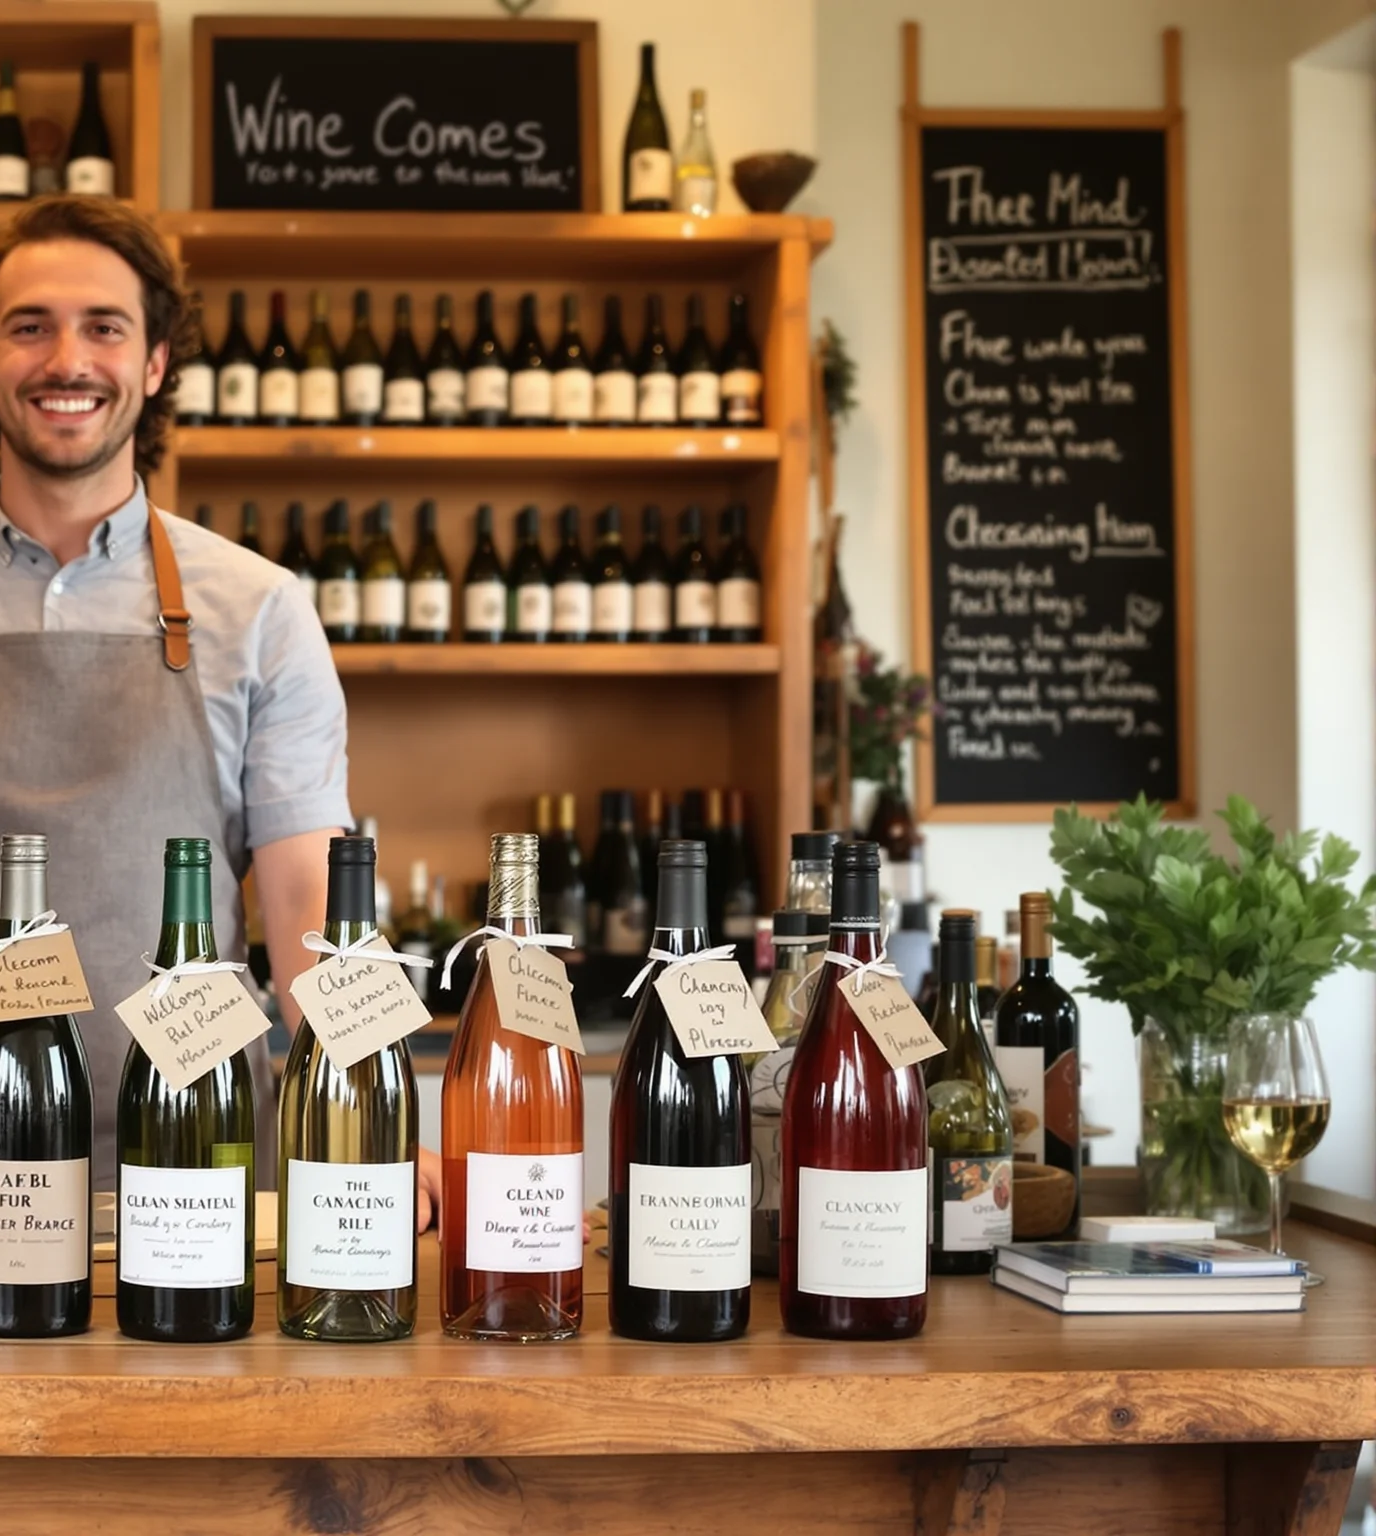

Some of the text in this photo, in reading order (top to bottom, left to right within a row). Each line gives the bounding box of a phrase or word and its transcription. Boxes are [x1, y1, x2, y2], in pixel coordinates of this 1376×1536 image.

[226, 74, 546, 162] Wine Comes
[345, 1181, 371, 1191] THE
[0, 1194, 31, 1208] FUR
[506, 1188, 565, 1201] CLEAND
[313, 1195, 395, 1209] CANACING
[519, 1206, 550, 1217] WINE
[339, 1217, 373, 1230] RILE
